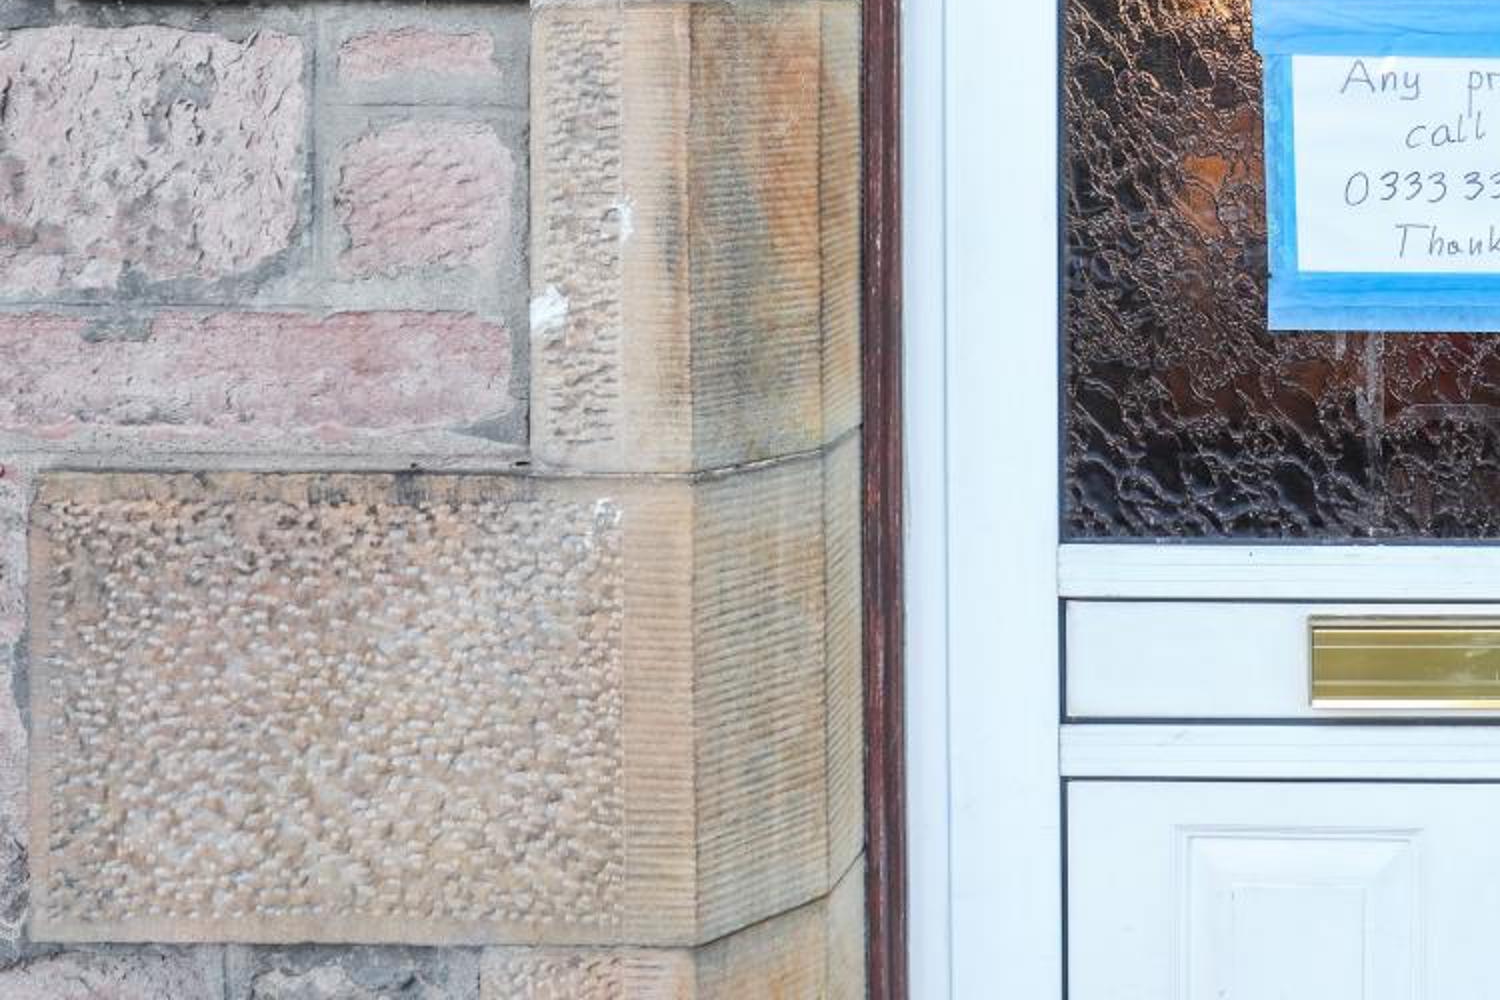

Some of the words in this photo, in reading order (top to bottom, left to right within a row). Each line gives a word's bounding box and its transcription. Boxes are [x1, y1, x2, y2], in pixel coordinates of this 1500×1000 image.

[1340, 60, 1420, 100] Any
[1405, 111, 1486, 149] call
[1345, 171, 1448, 206] 0333
